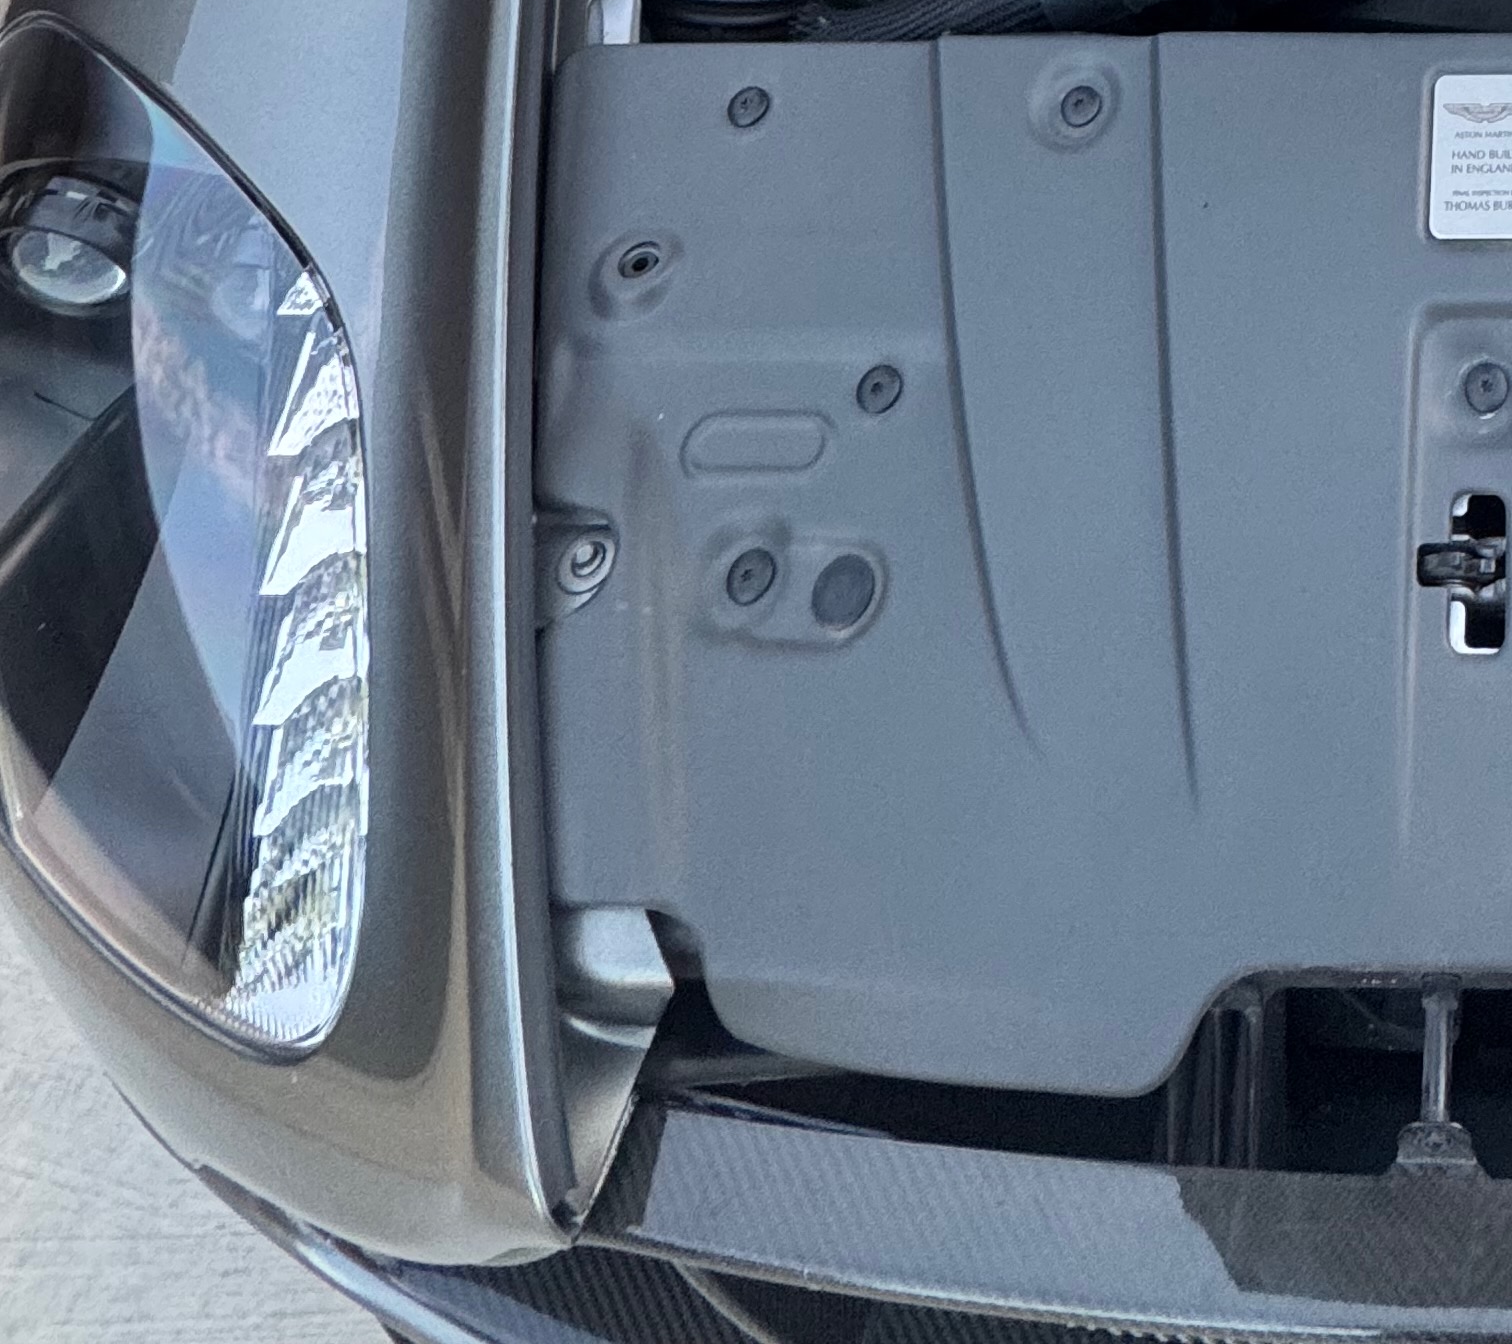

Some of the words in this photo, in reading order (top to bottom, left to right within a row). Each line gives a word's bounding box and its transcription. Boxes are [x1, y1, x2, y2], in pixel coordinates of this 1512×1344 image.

[1454, 130, 1483, 140] ASTON
[1451, 149, 1486, 160] HAND
[1450, 163, 1464, 174] IN
[1443, 200, 1491, 212] THOMAS
